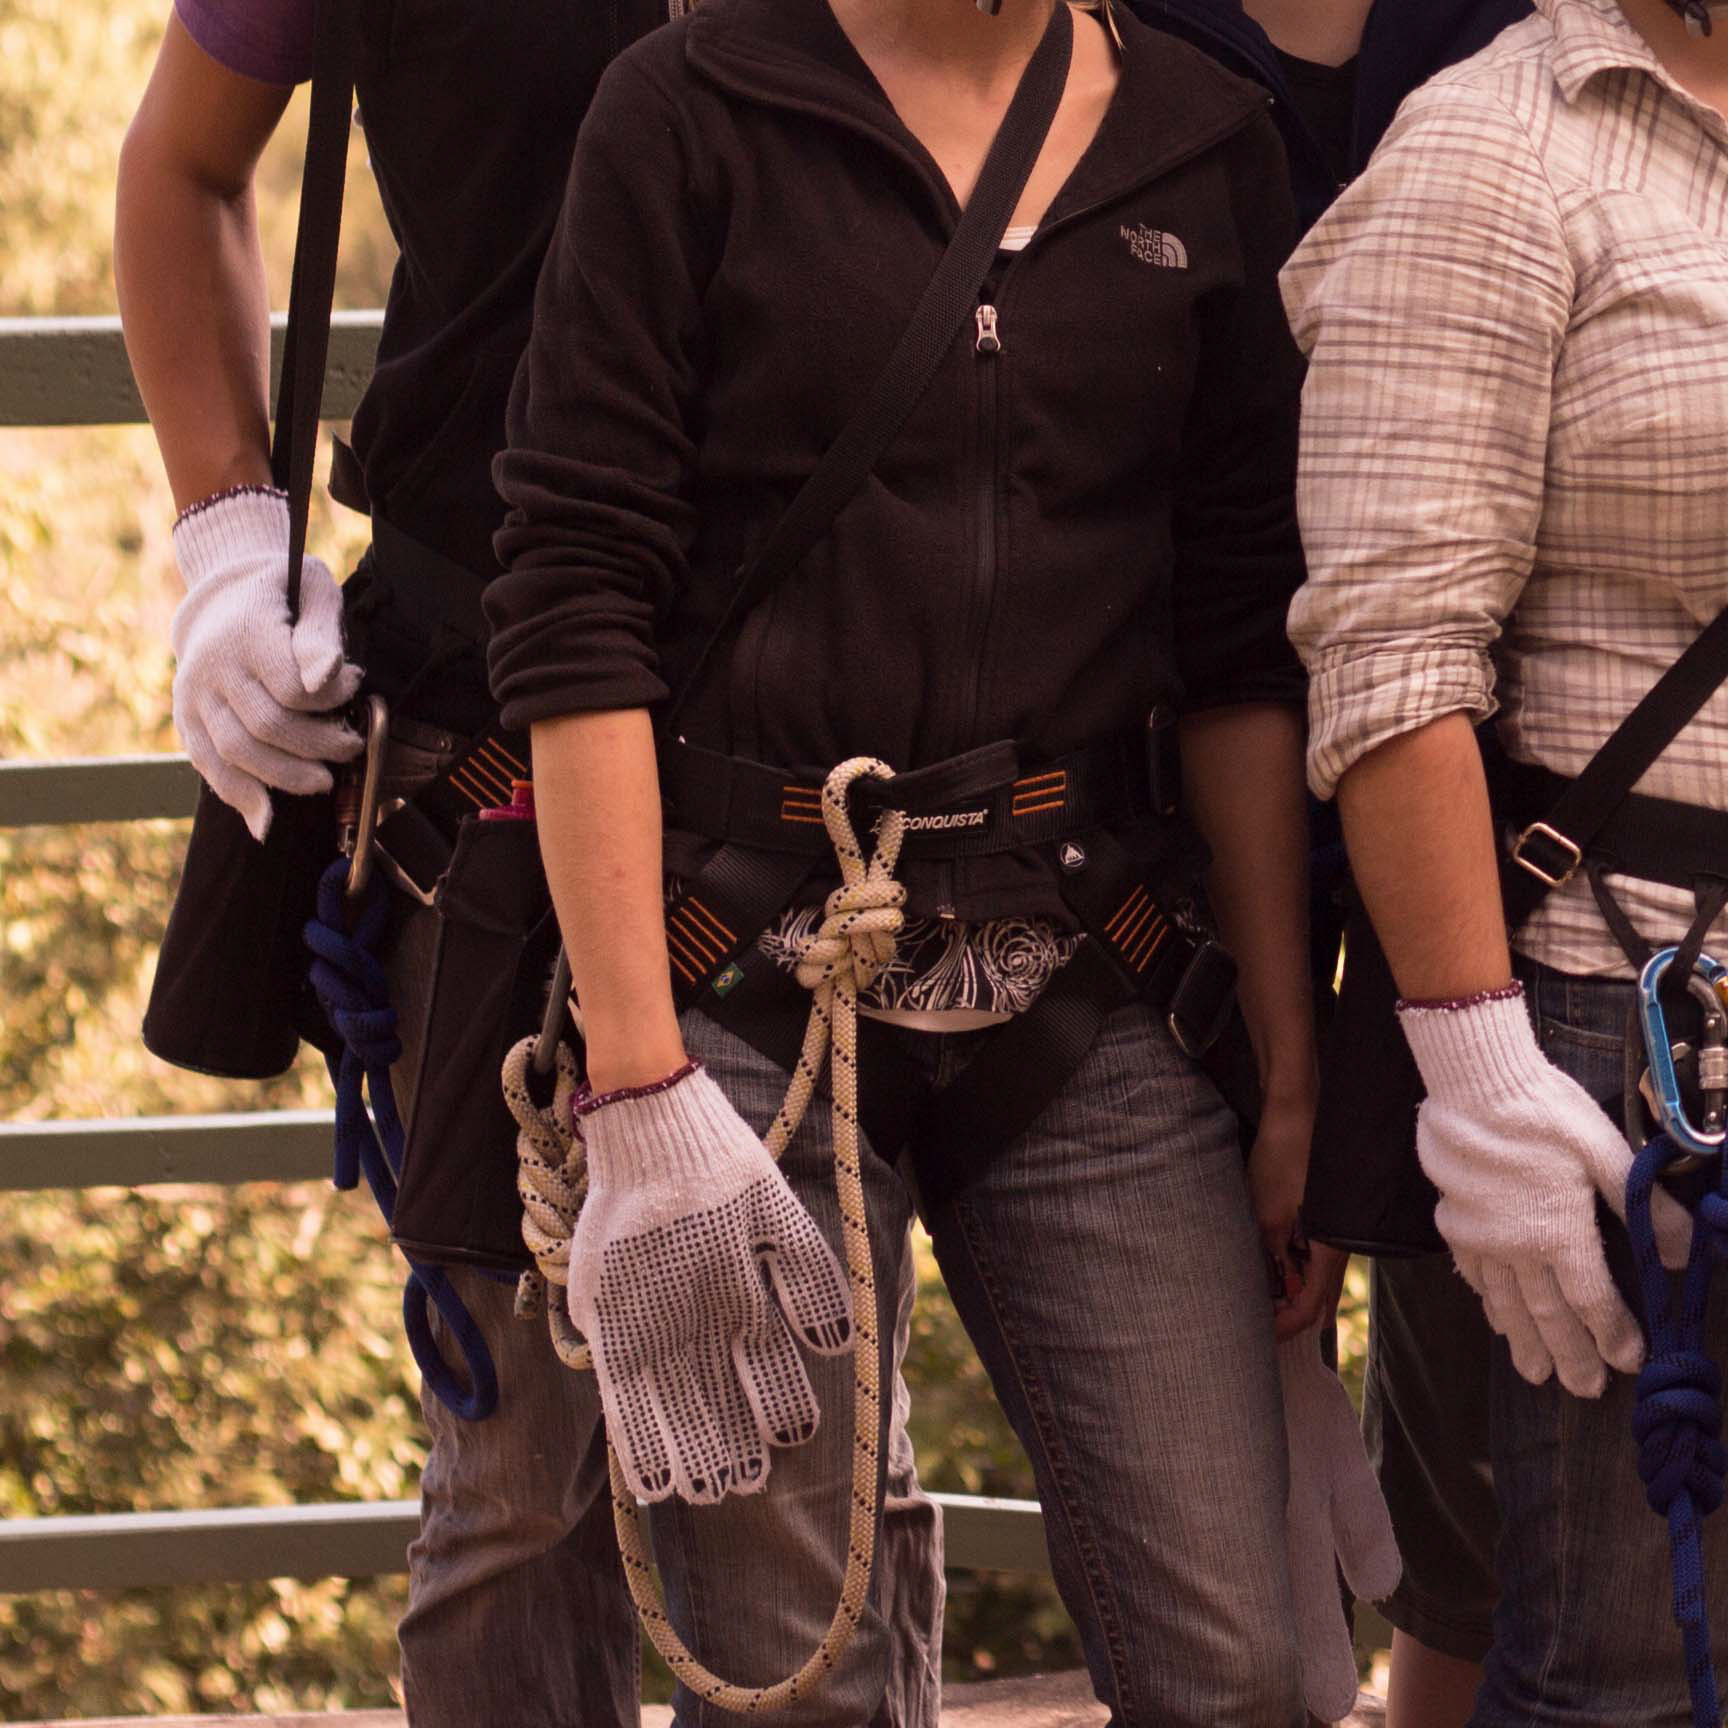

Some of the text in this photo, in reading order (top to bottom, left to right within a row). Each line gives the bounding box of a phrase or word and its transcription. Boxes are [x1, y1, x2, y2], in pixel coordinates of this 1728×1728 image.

[1120, 225, 1161, 253] NORTH
[1139, 223, 1161, 242] THE
[1130, 244, 1161, 266] FACE
